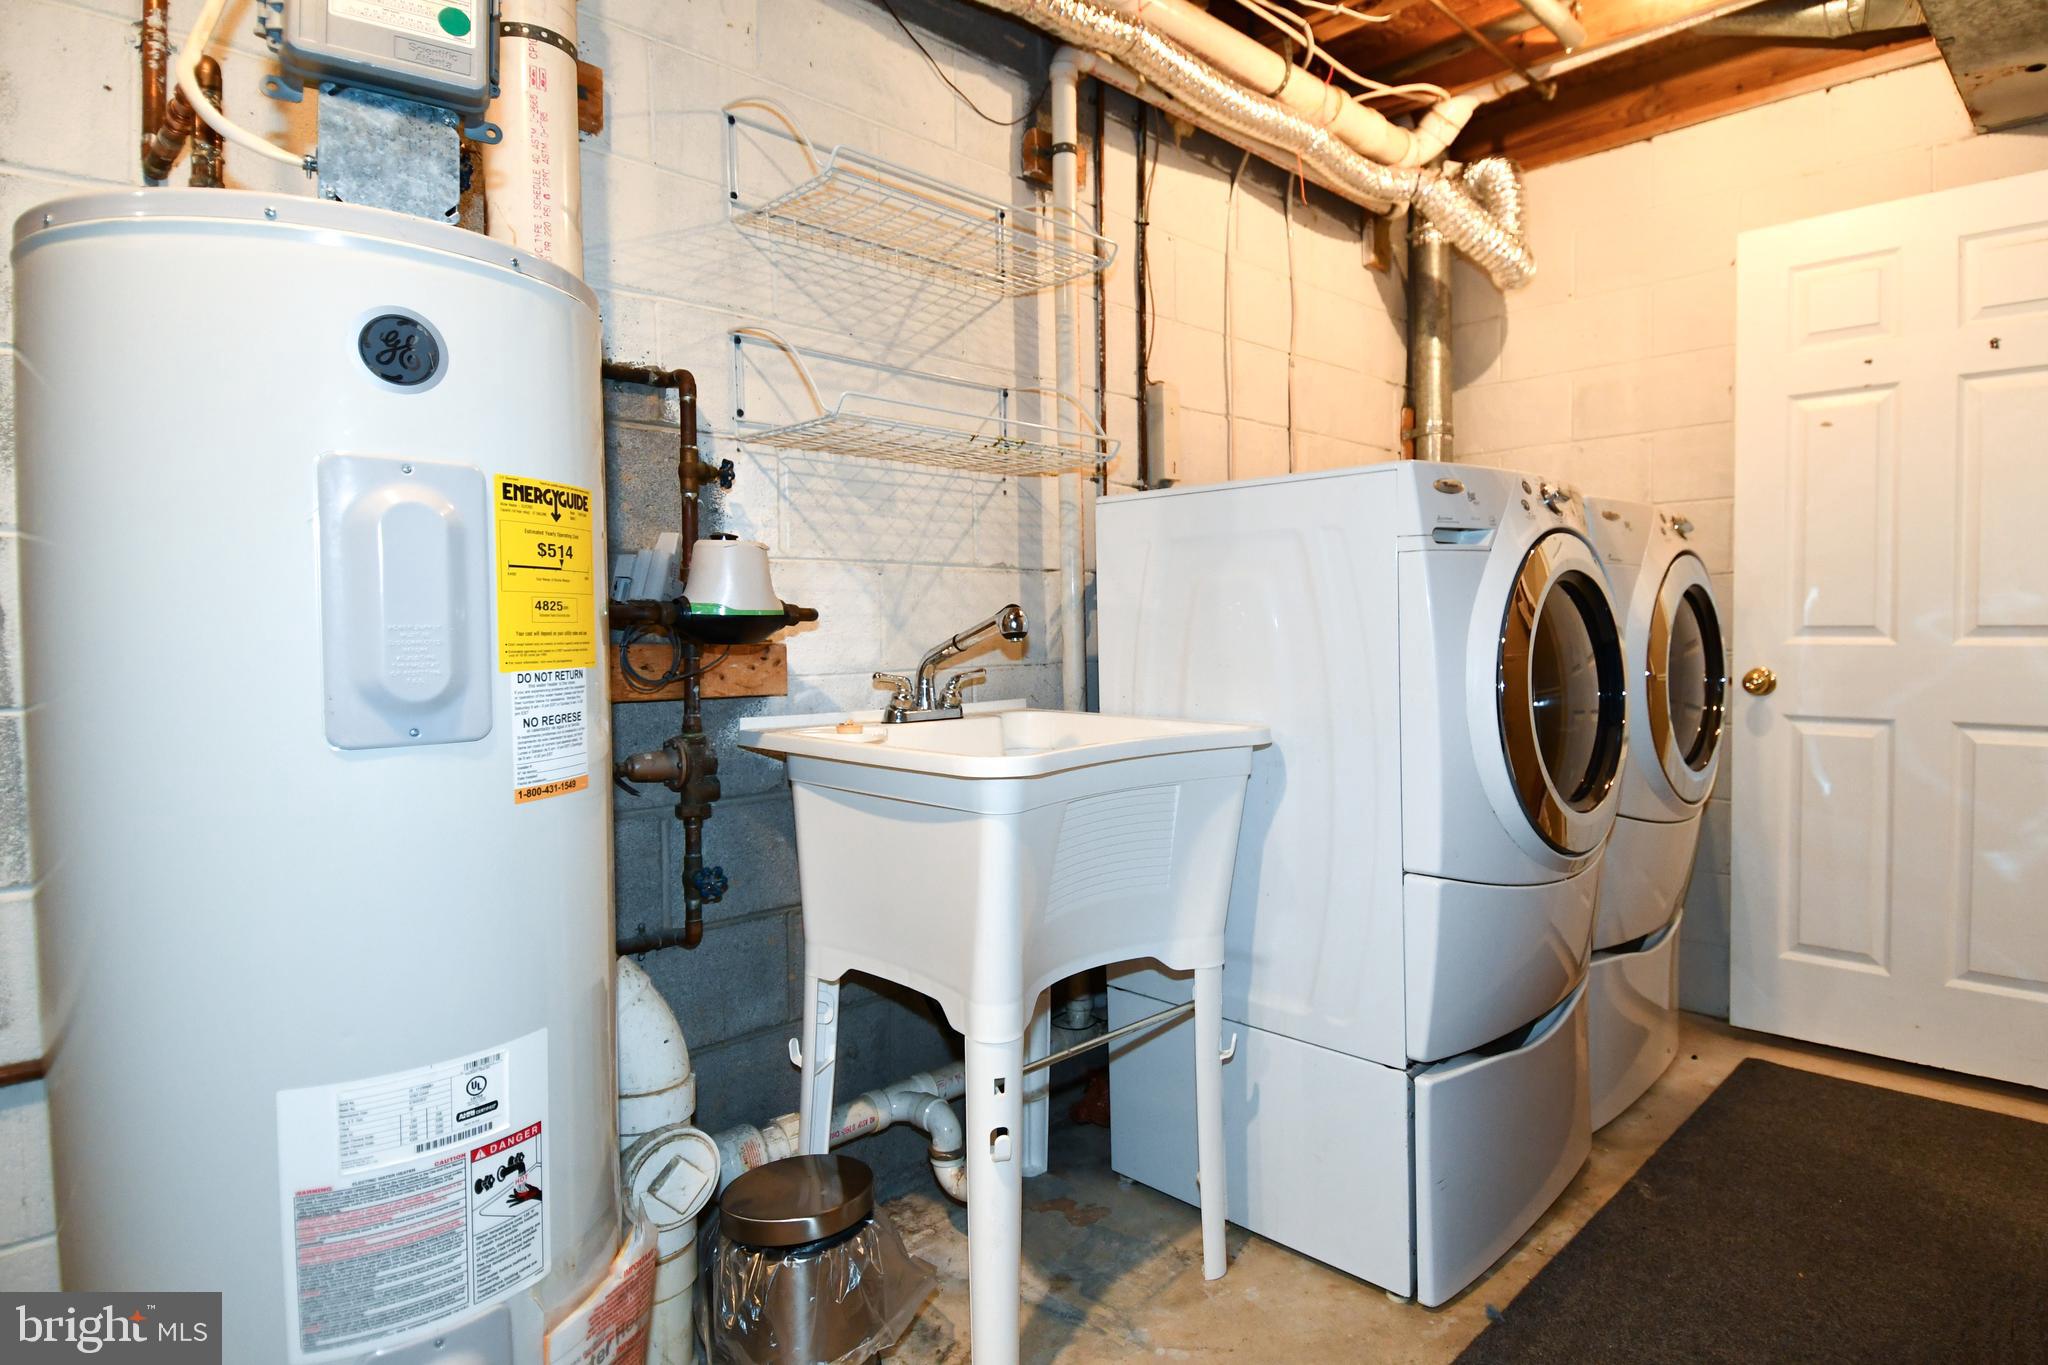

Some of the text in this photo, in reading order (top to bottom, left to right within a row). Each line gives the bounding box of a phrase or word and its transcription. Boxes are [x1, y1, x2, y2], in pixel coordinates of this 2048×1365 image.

[532, 169, 541, 210] SCHEDULE
[502, 482, 589, 512] ENERGYGUIDE
[537, 542, 574, 559] $514
[534, 600, 563, 612] 4825
[517, 669, 584, 684] DO NOT RETURN
[523, 711, 582, 728] NO REGRESE
[518, 779, 577, 799] 1-800-431-1549
[471, 1080, 482, 1091] UL
[490, 1126, 539, 1154] DANGER
[434, 1153, 467, 1167] CAUTION
[514, 1174, 528, 1186] HOT
